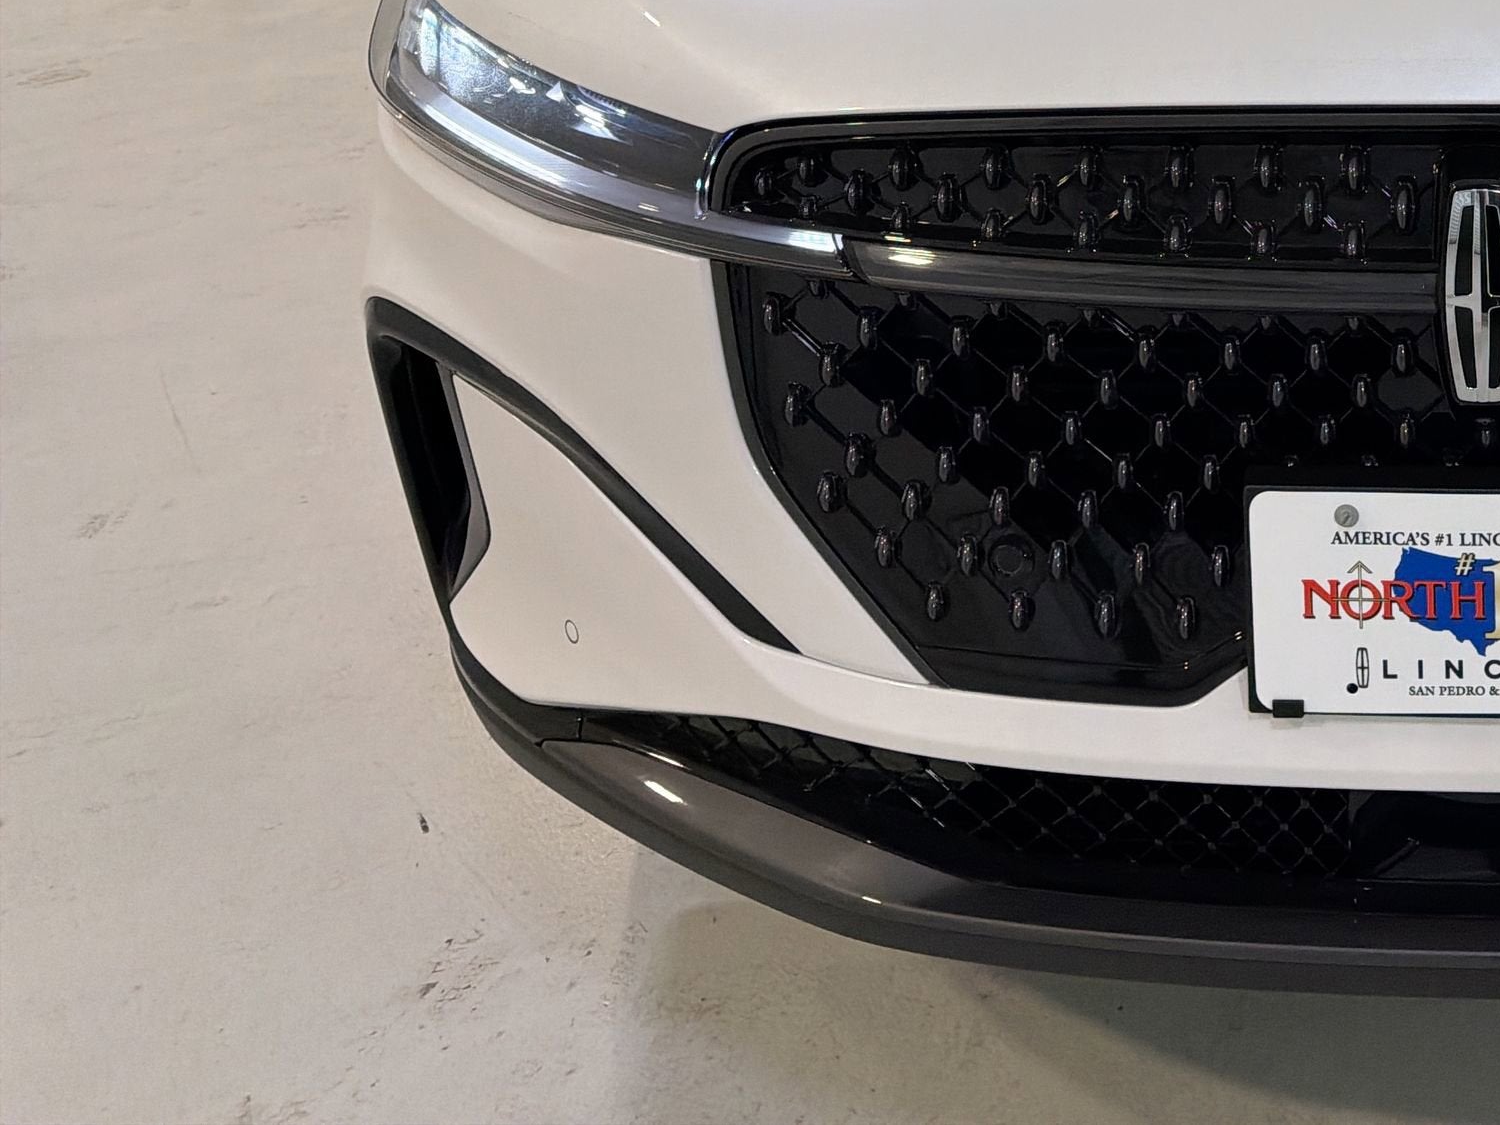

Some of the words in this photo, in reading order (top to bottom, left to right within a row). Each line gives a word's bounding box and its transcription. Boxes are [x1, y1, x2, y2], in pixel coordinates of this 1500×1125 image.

[1331, 531, 1430, 547] AMERICA'S
[1434, 532, 1454, 547] #1
[1301, 578, 1486, 621] NORTH
[1408, 686, 1437, 697] SAN
[1439, 686, 1486, 697] PEDRO
[1488, 686, 1500, 697] &
